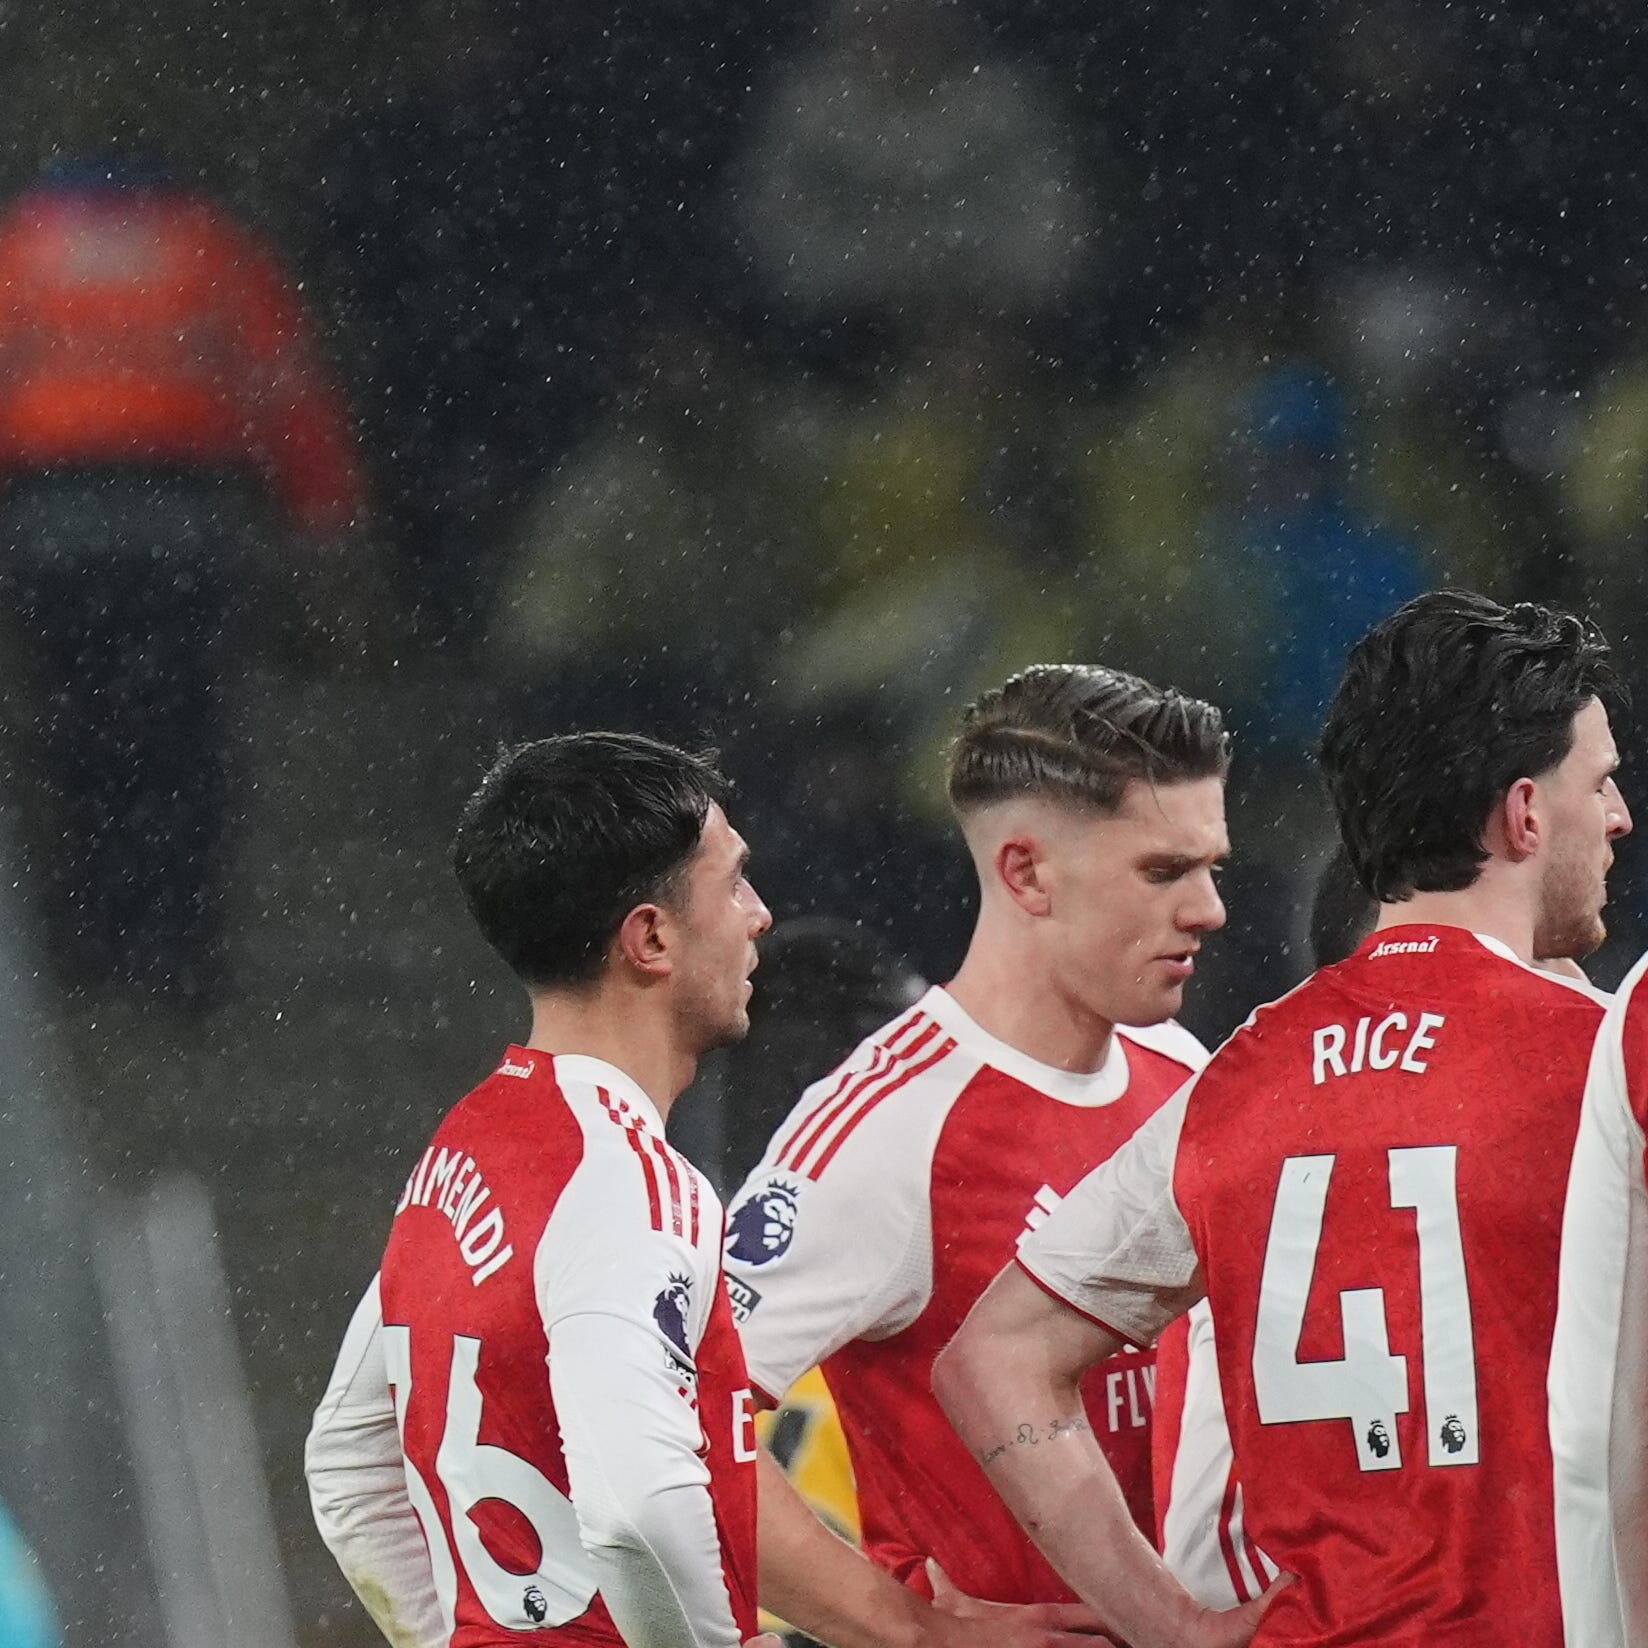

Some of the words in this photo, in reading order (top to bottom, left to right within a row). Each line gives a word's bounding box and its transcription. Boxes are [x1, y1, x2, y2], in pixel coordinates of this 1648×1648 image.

[1368, 935, 1440, 961] Arsenal
[1311, 1011, 1446, 1086] RICE
[1251, 1144, 1481, 1472] 41
